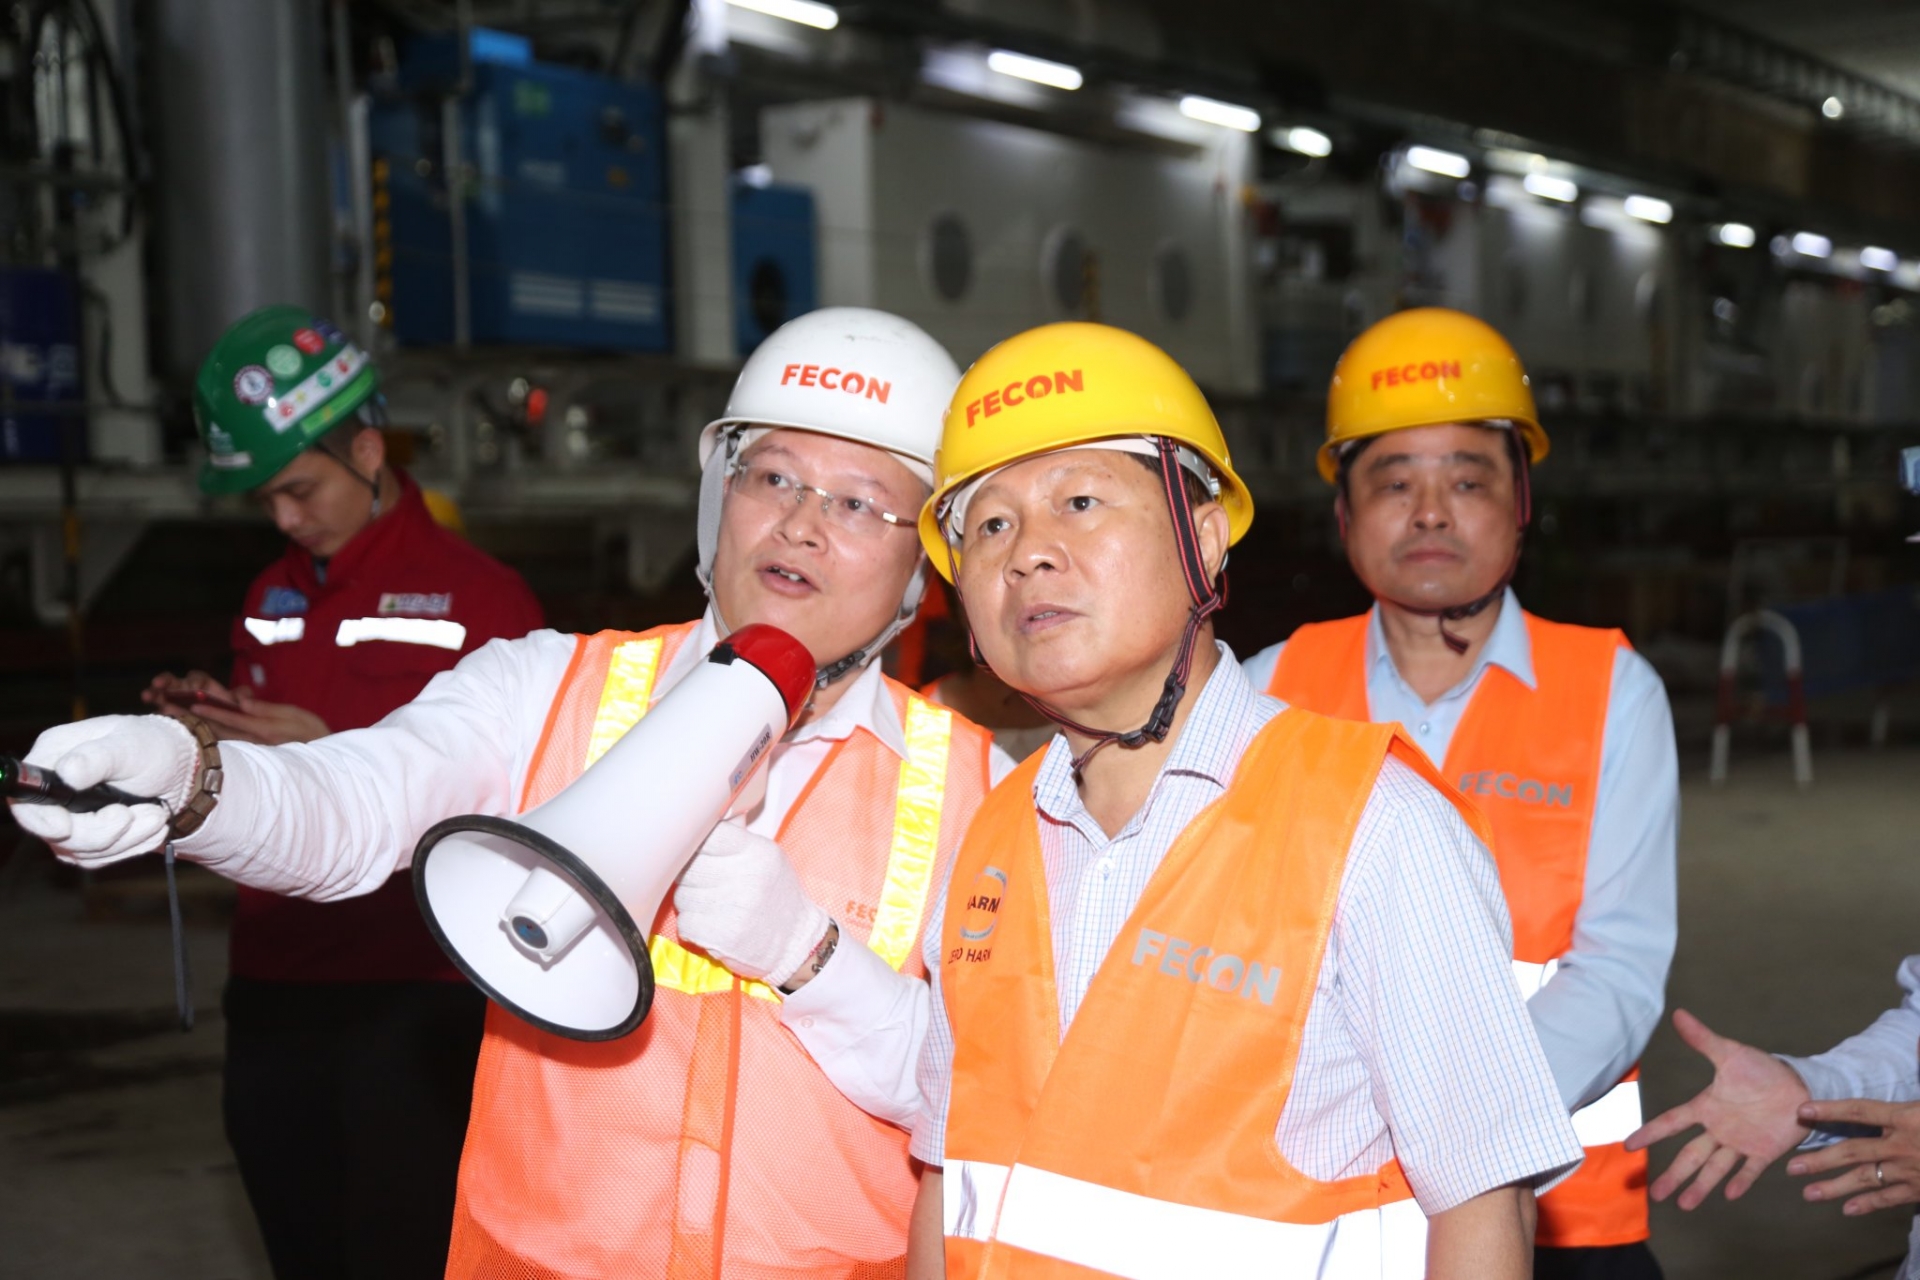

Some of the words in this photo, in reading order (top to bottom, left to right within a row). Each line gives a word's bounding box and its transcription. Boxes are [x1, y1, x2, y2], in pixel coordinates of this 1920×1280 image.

[780, 363, 892, 404] FECON
[1371, 360, 1462, 392] FECON
[965, 368, 1084, 429] FECON
[1459, 770, 1573, 807] FECON
[1132, 928, 1282, 1005] FECON
